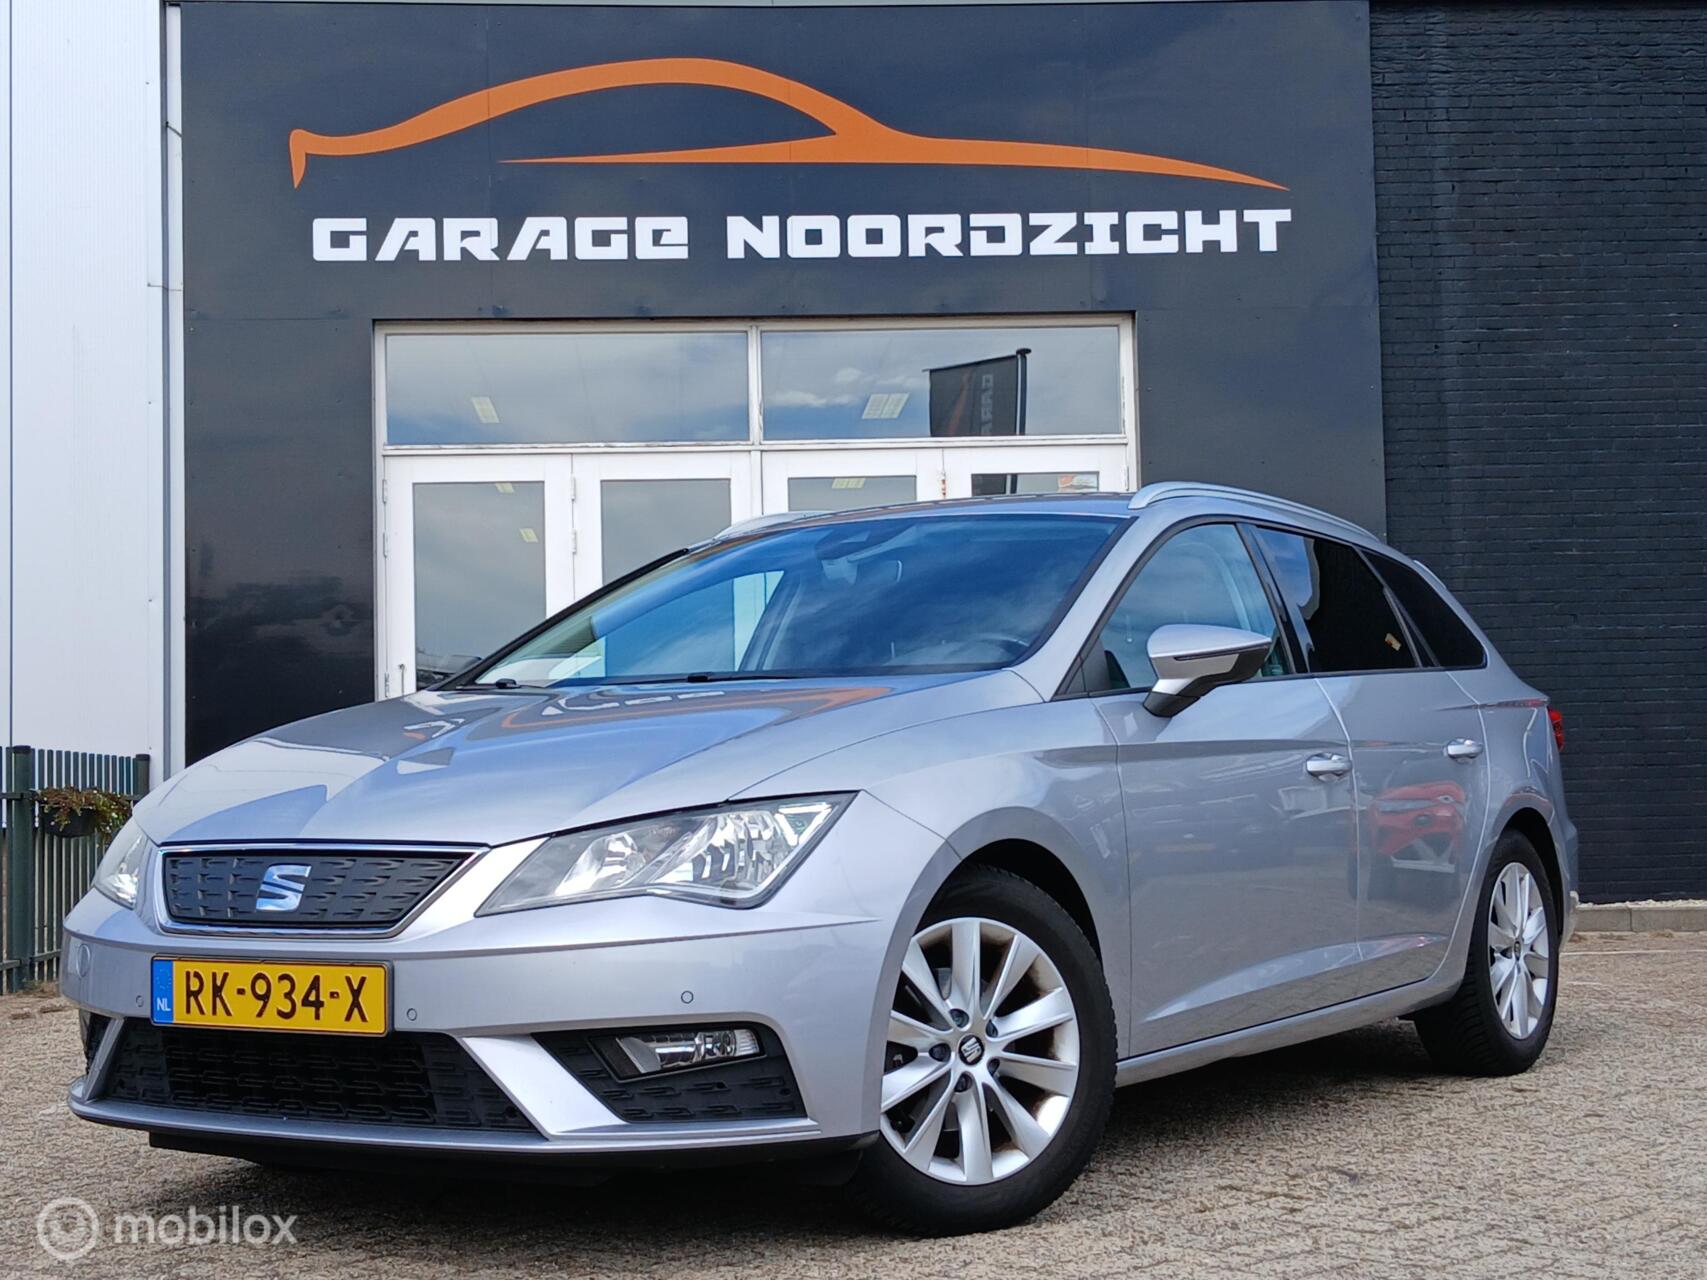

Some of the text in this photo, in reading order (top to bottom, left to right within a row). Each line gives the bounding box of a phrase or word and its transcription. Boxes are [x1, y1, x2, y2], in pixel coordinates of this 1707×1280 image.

[312, 208, 1292, 261] GARAGE NOORDZICHT
[156, 970, 369, 1023] NL RK-934-X
